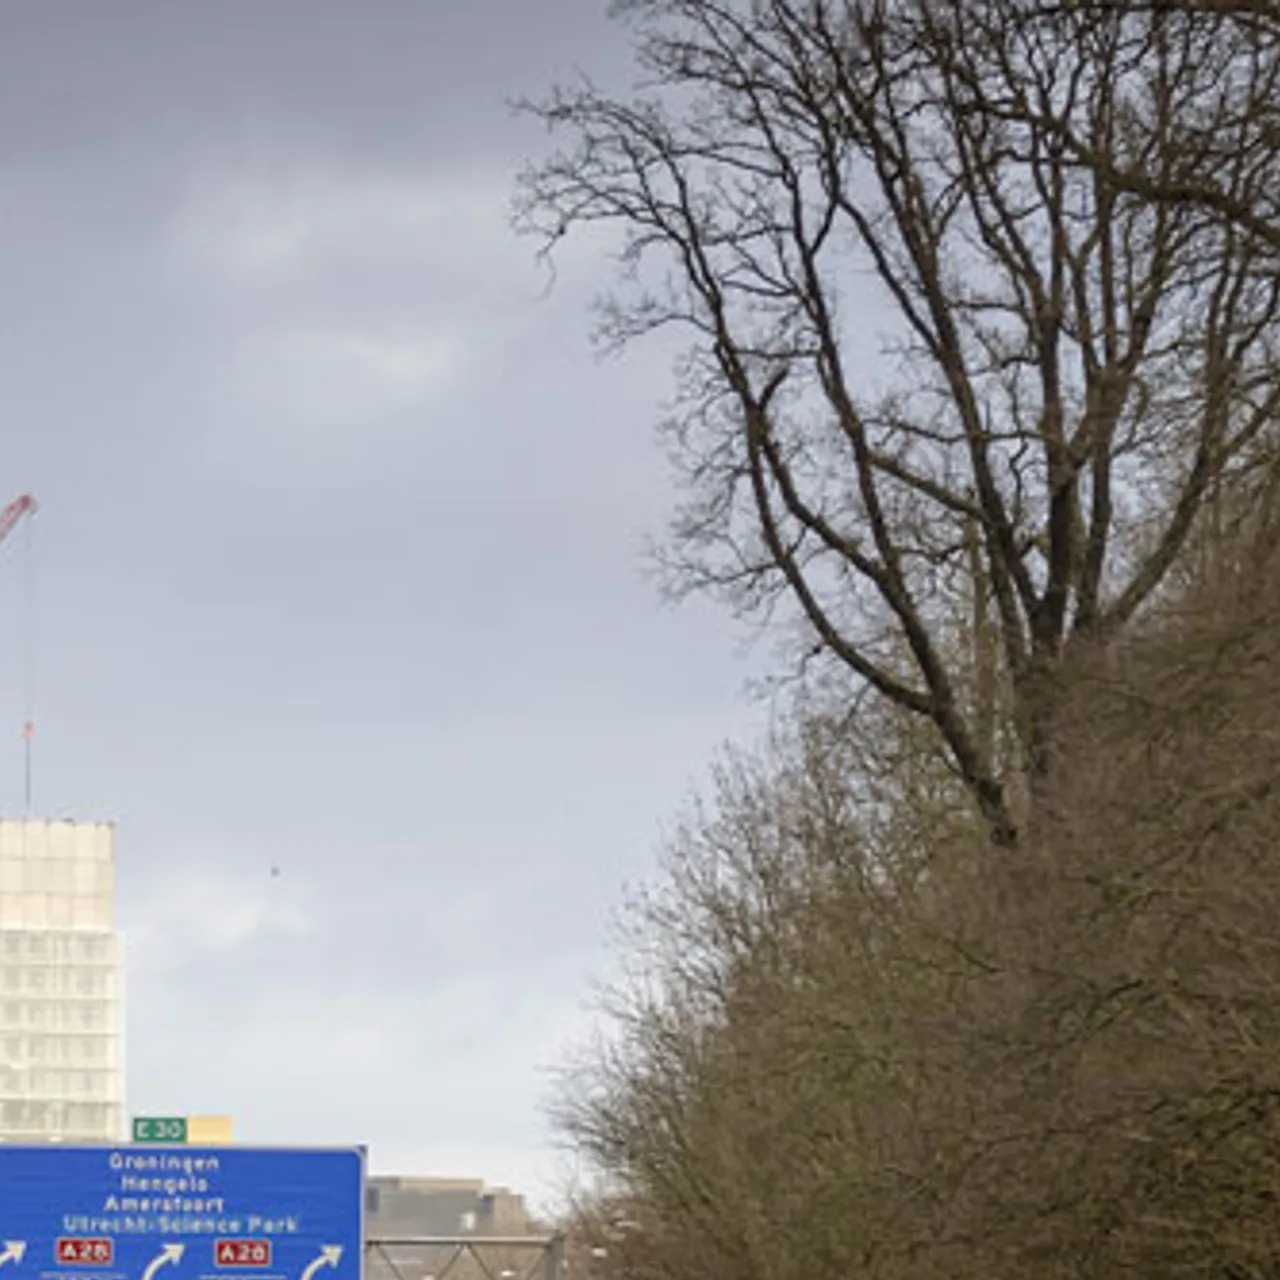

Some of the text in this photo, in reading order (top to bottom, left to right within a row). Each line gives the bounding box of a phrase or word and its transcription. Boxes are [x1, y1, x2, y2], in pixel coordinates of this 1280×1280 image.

[137, 1122, 182, 1138] E 30
[109, 1152, 219, 1174] Groningen
[121, 1176, 209, 1195] Hengelo
[104, 1195, 224, 1212] Amersfoort
[248, 1214, 299, 1232] Park
[63, 1243, 108, 1261] A28
